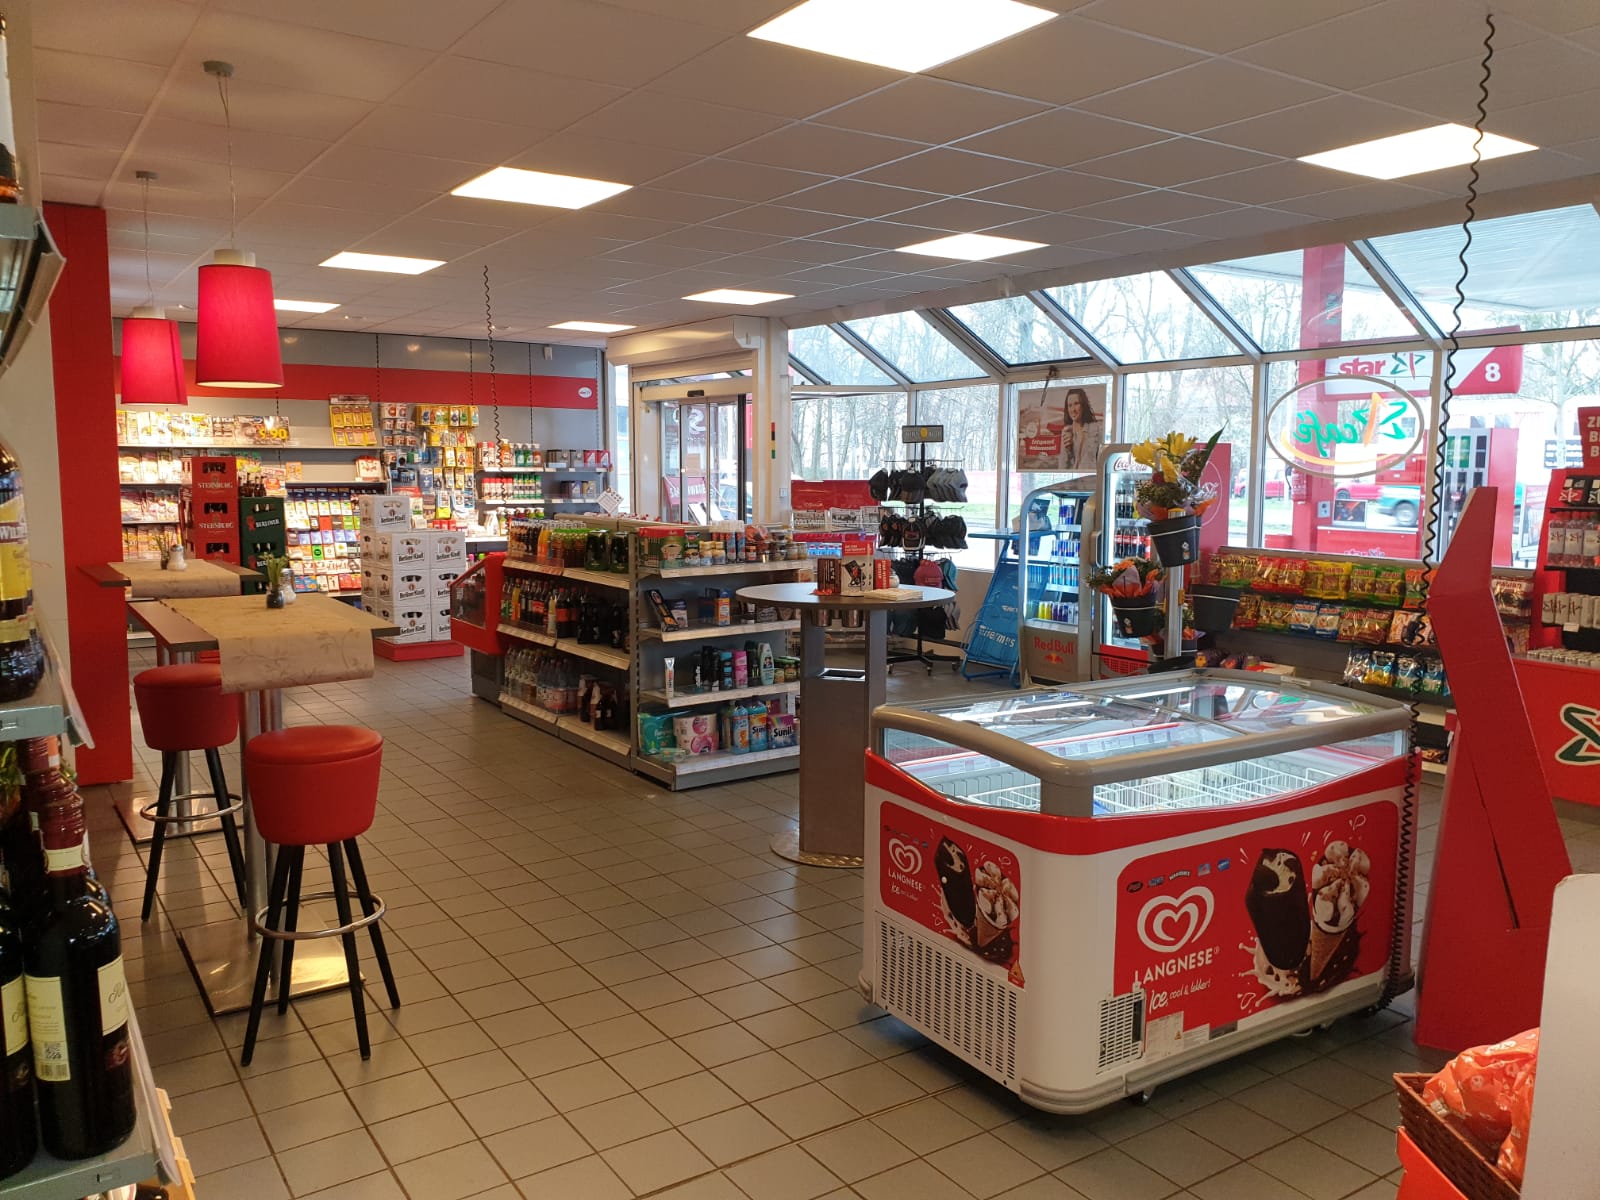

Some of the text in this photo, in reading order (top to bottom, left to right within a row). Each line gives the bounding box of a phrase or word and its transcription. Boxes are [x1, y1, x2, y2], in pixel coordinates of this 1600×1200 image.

[1340, 356, 1386, 376] star
[1484, 362, 1501, 382] 8
[1034, 636, 1074, 655] Red Bull
[773, 725, 793, 737] Sunil
[888, 866, 923, 892] LANGNESE
